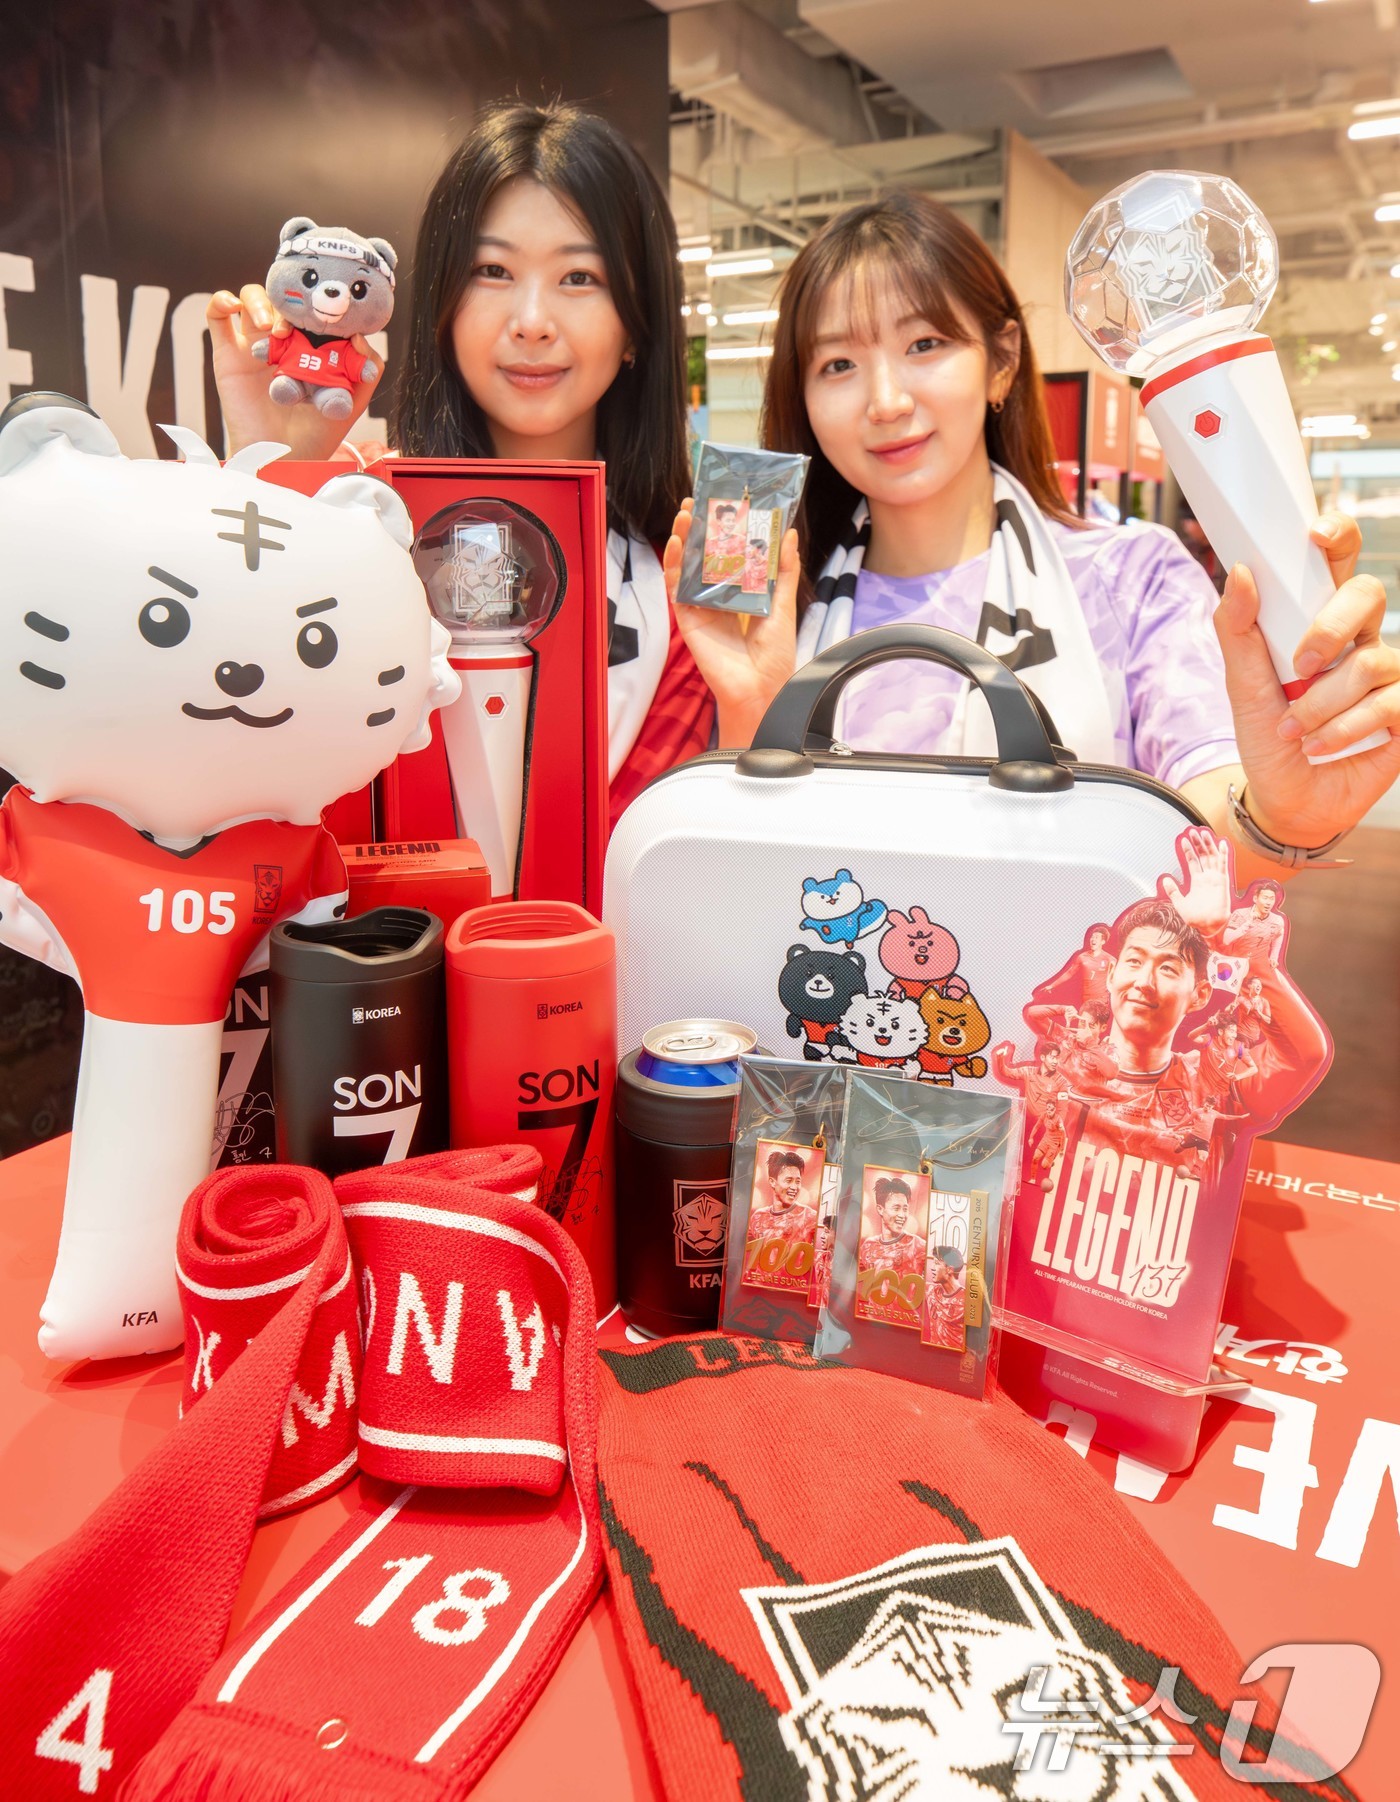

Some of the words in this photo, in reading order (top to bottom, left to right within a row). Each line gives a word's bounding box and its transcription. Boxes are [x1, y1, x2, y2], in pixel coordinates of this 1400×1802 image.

[318, 241, 357, 254] KNPS
[299, 354, 322, 371] 33
[355, 842, 441, 858] LEGEND
[139, 888, 236, 935] 105
[365, 1006, 401, 1020] KOREA
[549, 1001, 583, 1015] KOREA
[333, 1064, 422, 1111] SON
[517, 1059, 600, 1105] SON
[333, 1102, 422, 1166] 7
[517, 1096, 601, 1224] 7
[1031, 1141, 1200, 1309] LEGEND
[745, 1238, 813, 1279] 100
[970, 1217, 982, 1269] CENTURY
[689, 1273, 722, 1289] KFA
[780, 1277, 807, 1288] SUNG
[858, 1270, 925, 1311] 100
[969, 1271, 979, 1299] CLUB
[1034, 1269, 1057, 1281] ALL-TIME
[1057, 1276, 1092, 1294] APPEARANCE
[1091, 1289, 1114, 1302] RECORD
[1113, 1295, 1137, 1309] HOLDER
[1136, 1303, 1148, 1314] FOR
[1148, 1306, 1168, 1320] KOREA
[1128, 1264, 1188, 1299] 137
[122, 1311, 158, 1327] KFA
[893, 1311, 920, 1323] SUNG
[686, 1337, 817, 1372] LEE
[1062, 1370, 1070, 1379] All
[1070, 1373, 1089, 1387] Rights
[355, 1553, 511, 1647] 18
[35, 1668, 114, 1795] 4
